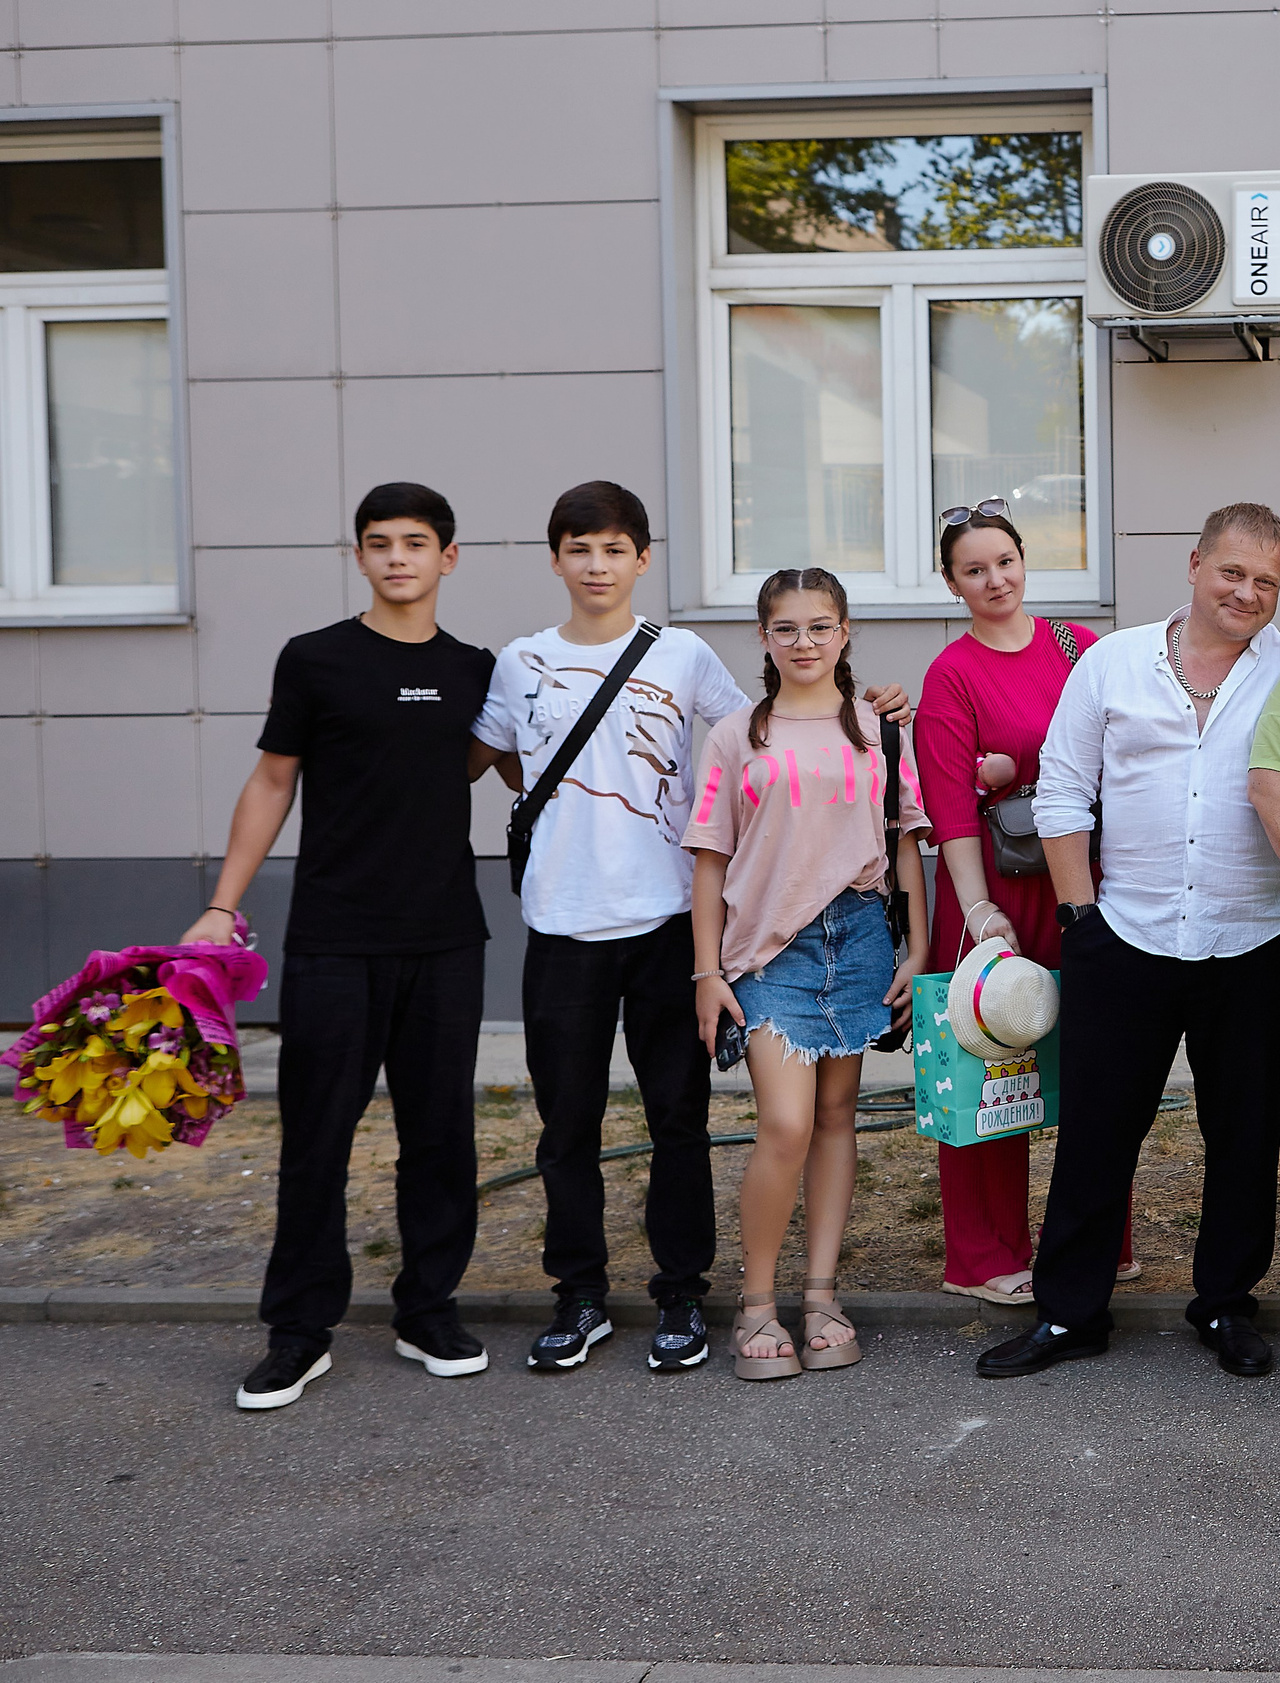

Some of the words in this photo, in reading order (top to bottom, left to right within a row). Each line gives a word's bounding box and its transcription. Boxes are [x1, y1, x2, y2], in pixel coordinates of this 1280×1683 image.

[1250, 206, 1269, 296] ONEAIR
[534, 692, 668, 722] BURRRY
[992, 1081, 998, 1096] С
[1002, 1075, 1030, 1096] ДНЁМ
[981, 1102, 1040, 1130] РОЖДЕНИЯ!
